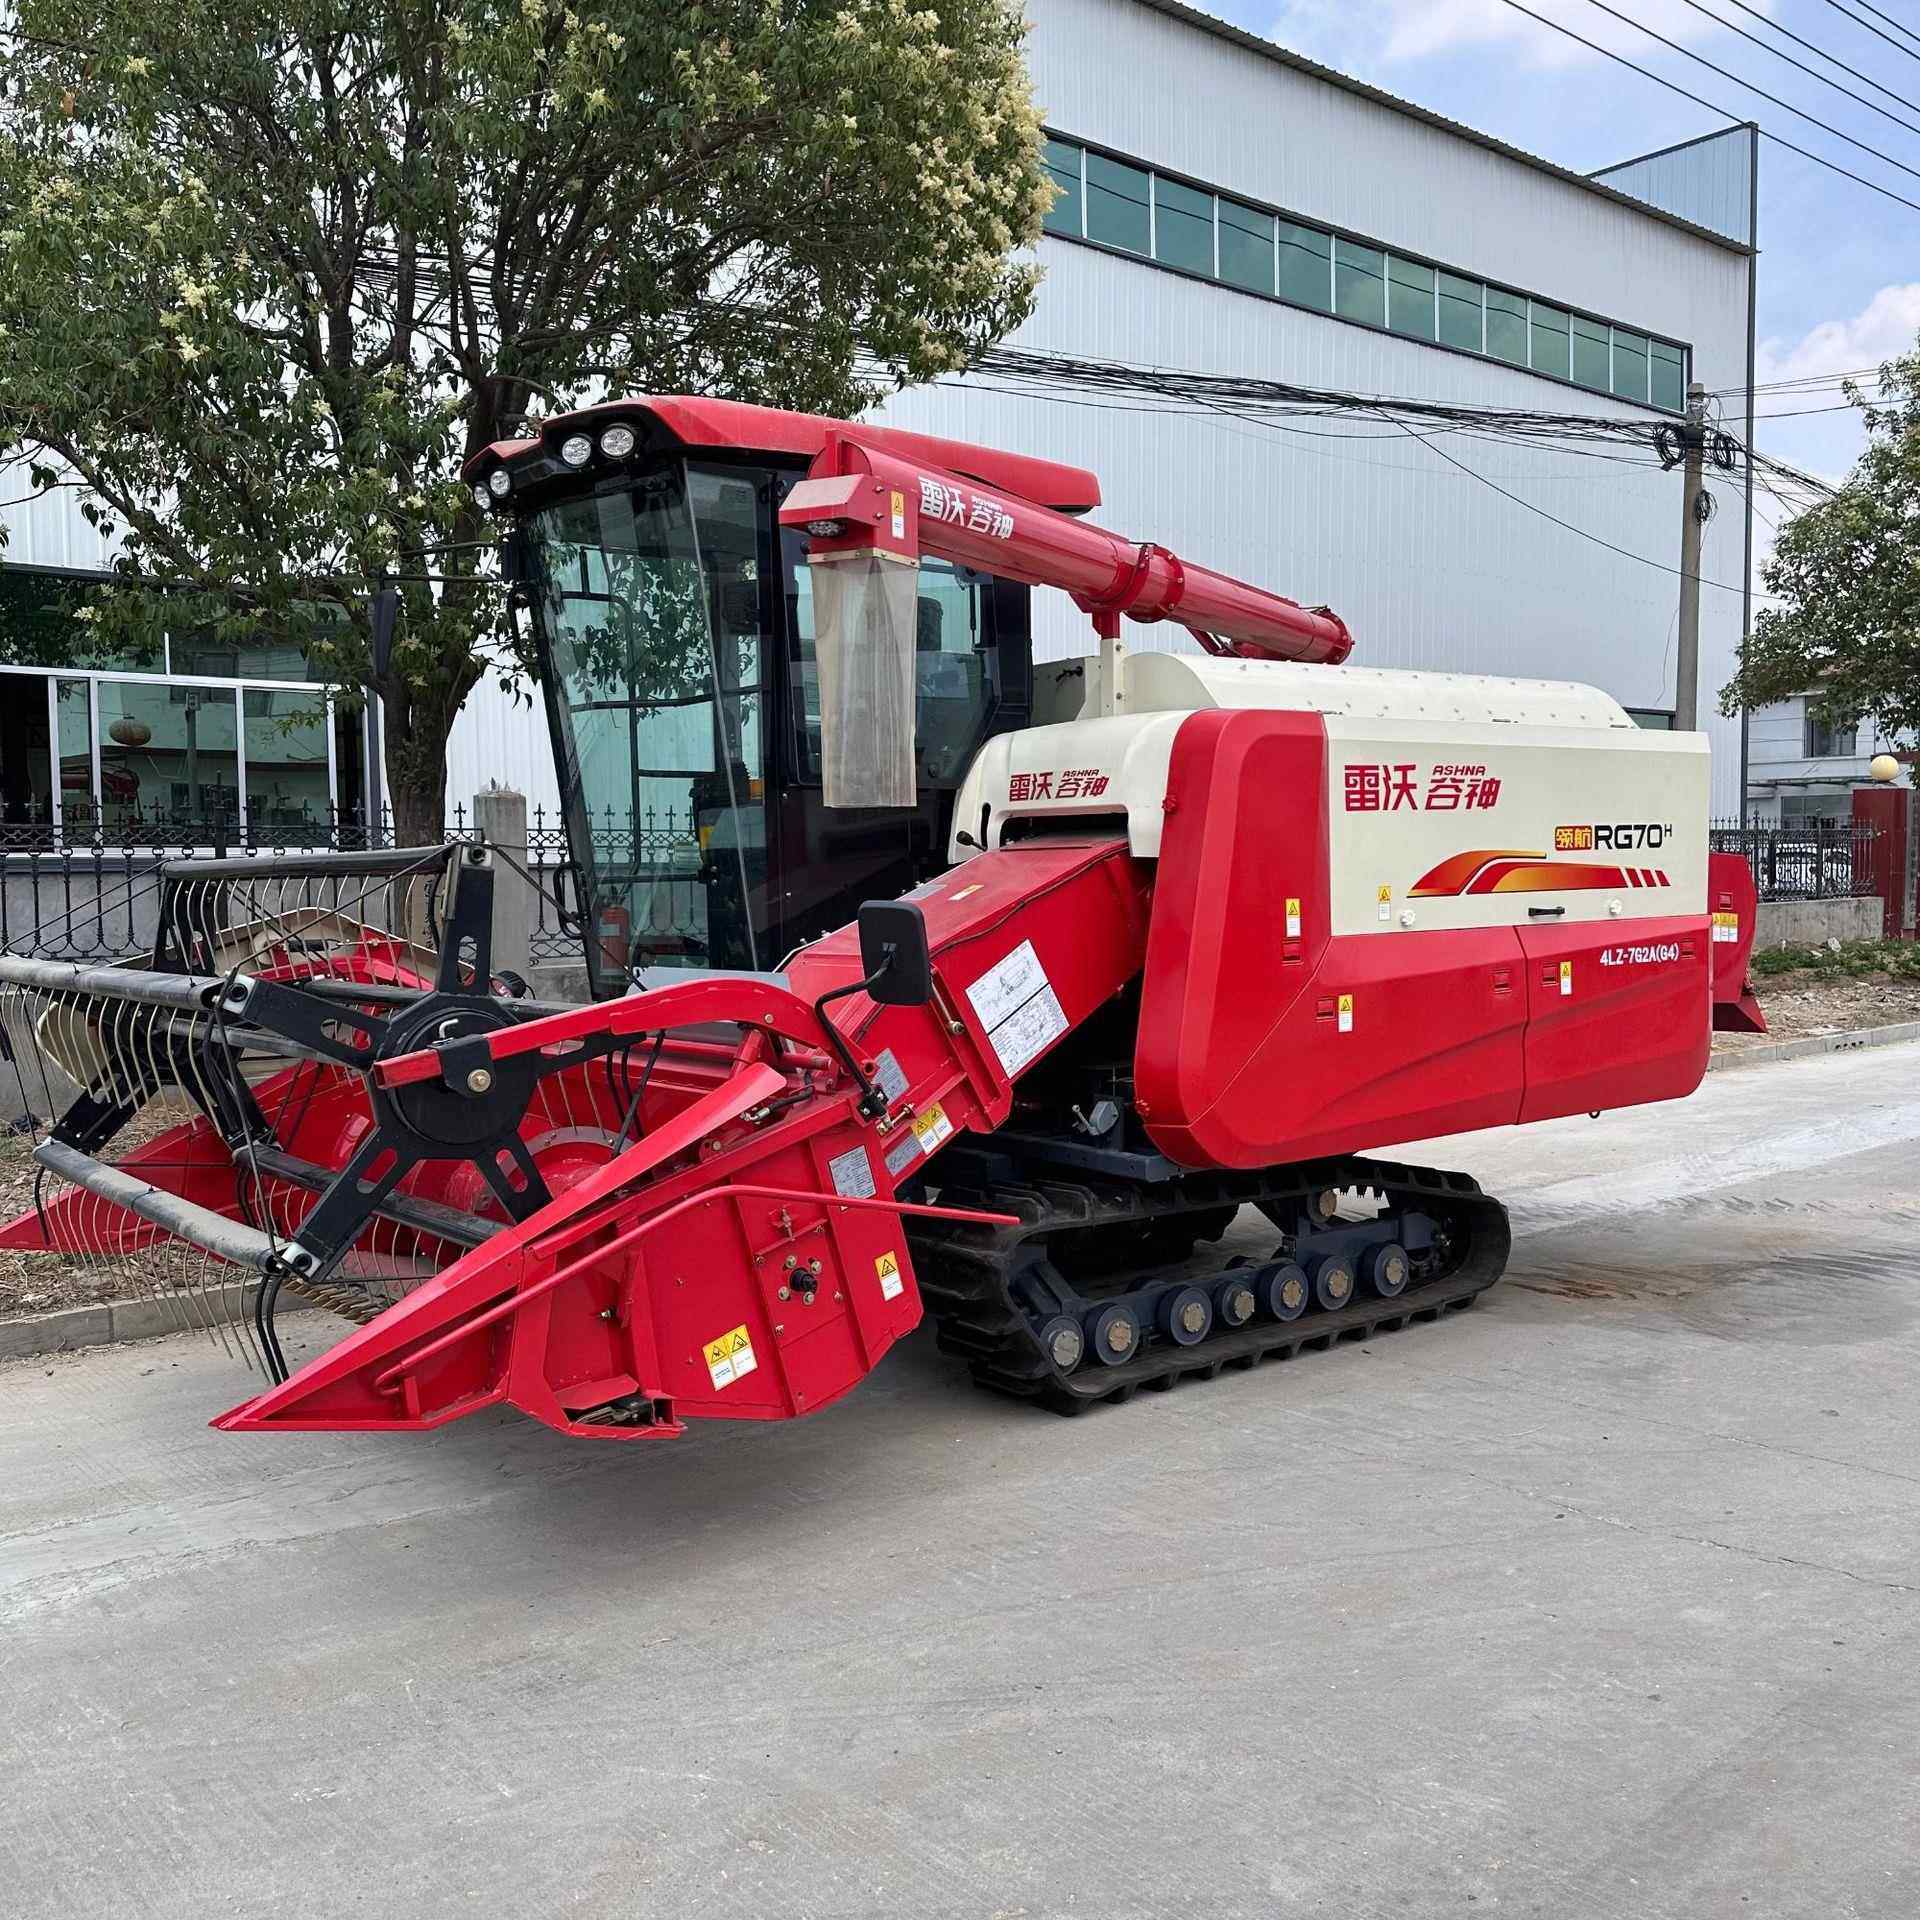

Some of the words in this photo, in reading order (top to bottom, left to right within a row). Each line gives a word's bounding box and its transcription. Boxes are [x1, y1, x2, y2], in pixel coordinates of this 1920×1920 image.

[1063, 769, 1100, 778] ASHNA
[1432, 765, 1487, 776] ASHNA
[1600, 943, 1679, 966] 4LZ-7G2A(G4)
